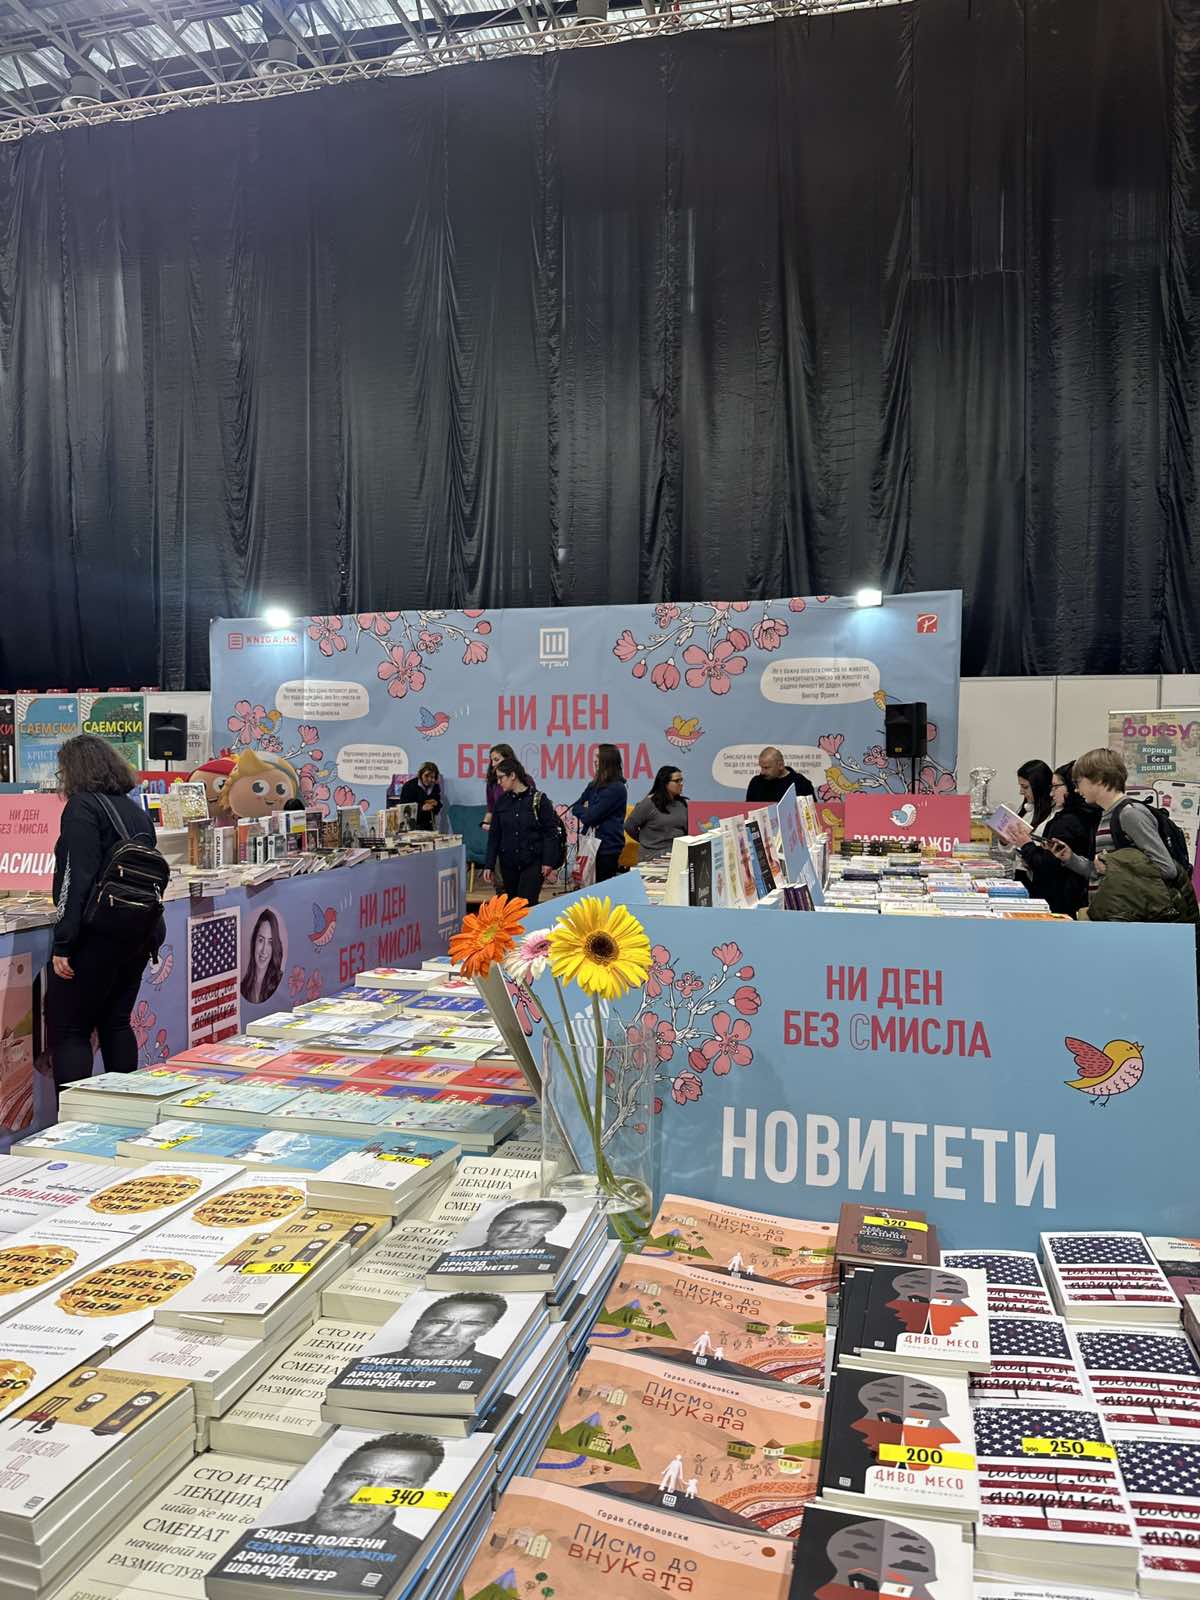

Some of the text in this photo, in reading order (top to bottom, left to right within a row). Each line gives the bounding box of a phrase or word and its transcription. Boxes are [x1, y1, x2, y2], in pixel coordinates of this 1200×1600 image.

[498, 693, 609, 737] НИ ДЕН
[83, 720, 143, 734] САЕМСКИ
[457, 743, 492, 780] БЕ
[1151, 755, 1165, 763] без
[9, 808, 40, 822] НИ ДЕН
[360, 883, 406, 929] НИ ДЕН
[339, 942, 366, 983] БЕЗ
[825, 964, 944, 1010] НИ ДЕН
[783, 1009, 992, 1058] БЕЗ СМИСЛА
[721, 1106, 1057, 1210] НОВИТЕТИ
[463, 1167, 538, 1180] СТО И ЕДНА
[456, 1178, 512, 1190] ЛЕКЦИЈА
[259, 1210, 283, 1218] СО
[444, 1201, 482, 1212] СМЕН
[208, 1215, 250, 1224] ПАРИ
[0, 1253, 73, 1266] ОГАТСТВО
[494, 1248, 546, 1256] ПОЛЕЗНИ
[32, 1268, 56, 1276] СЕ
[101, 1267, 193, 1281] БОГАТСТВО
[436, 1264, 519, 1273] ШВАРЦЕНЕГЕР
[14, 1277, 39, 1286] СО
[86, 1277, 177, 1292] ШТО НЕ СЕ
[67, 1287, 162, 1303] КУПУВА СО
[74, 1300, 122, 1312] ПАРИ
[317, 1328, 367, 1340] СТО И
[904, 1334, 981, 1349] ДИВО МЕСО
[303, 1338, 363, 1352] ЛЕКЦИ
[281, 1360, 340, 1375] СМЕНА
[360, 1356, 473, 1367] БИДЕТЕ ПОЛЕЗНИ
[341, 1378, 437, 1388] ШВАРЦЕНЕГЕР
[347, 1371, 402, 1381] АРНОЛД
[663, 1370, 740, 1397] Горан Стефановски
[255, 1384, 327, 1400] РАЗМИСЛУ
[1050, 1440, 1085, 1454] 250
[906, 1447, 943, 1464] 200
[193, 1467, 291, 1492] СТО И ЕД
[874, 1469, 964, 1490] ДИВО МЕСО
[174, 1484, 263, 1509] ЛЕКЦИЈА
[385, 1489, 425, 1506] 340
[143, 1517, 230, 1543] СМЕНАТ
[597, 1510, 690, 1543] Горан Стефановски
[254, 1528, 387, 1550] БИДЕТЕ ПОЛЕЗНИ
[197, 1551, 217, 1561] на
[233, 1550, 299, 1568] АРНОЛД
[107, 1553, 204, 1581] РАЗМИСЛУВ
[223, 1561, 338, 1582] ШВАРЦЕНЕГЕР
